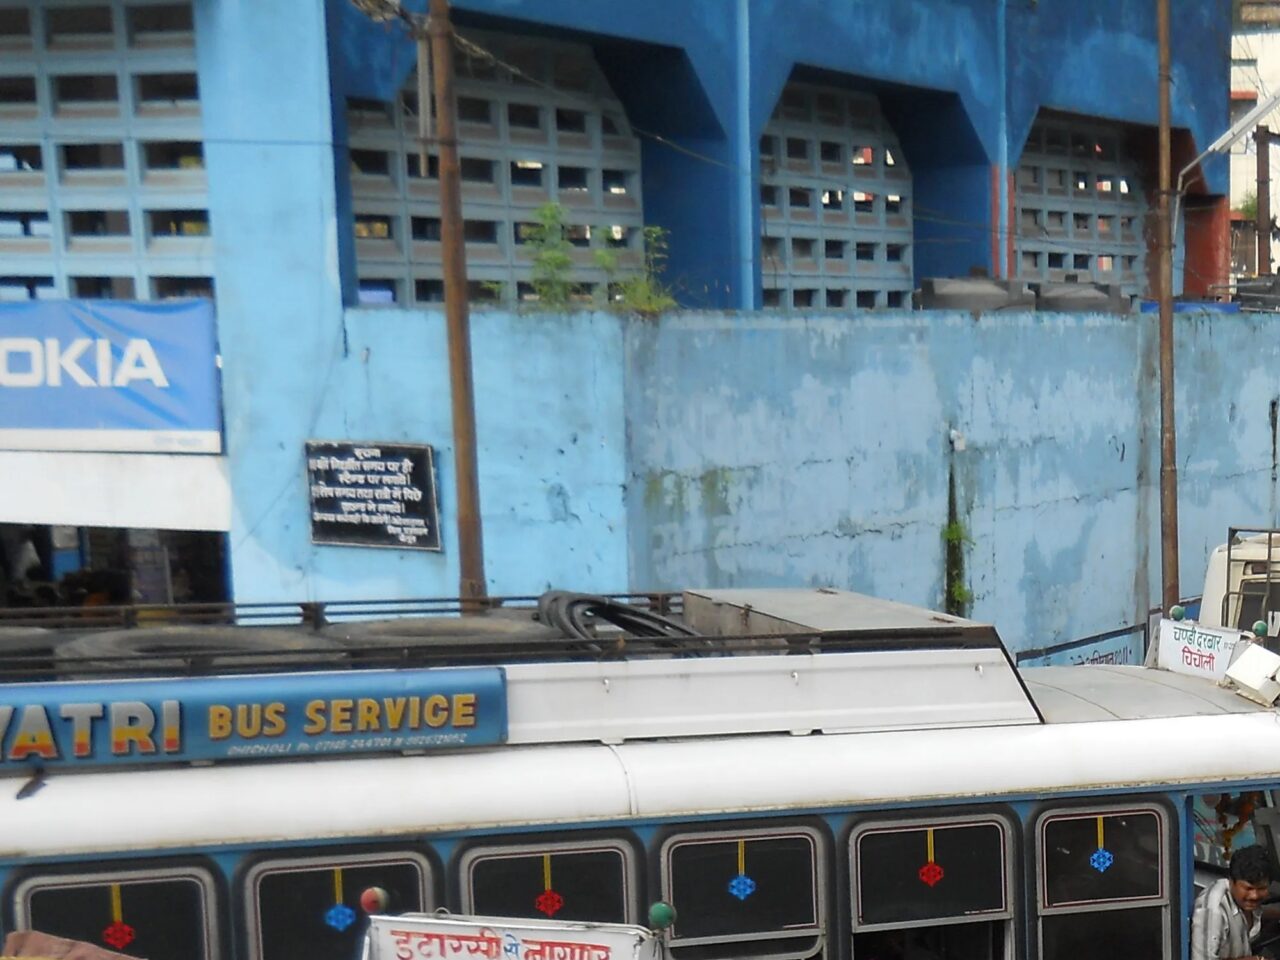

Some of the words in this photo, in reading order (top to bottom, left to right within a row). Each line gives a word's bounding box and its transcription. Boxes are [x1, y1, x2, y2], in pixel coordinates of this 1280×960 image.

[208, 702, 287, 740] BUS
[303, 693, 477, 735] SERVICE
[503, 933, 521, 960] से
